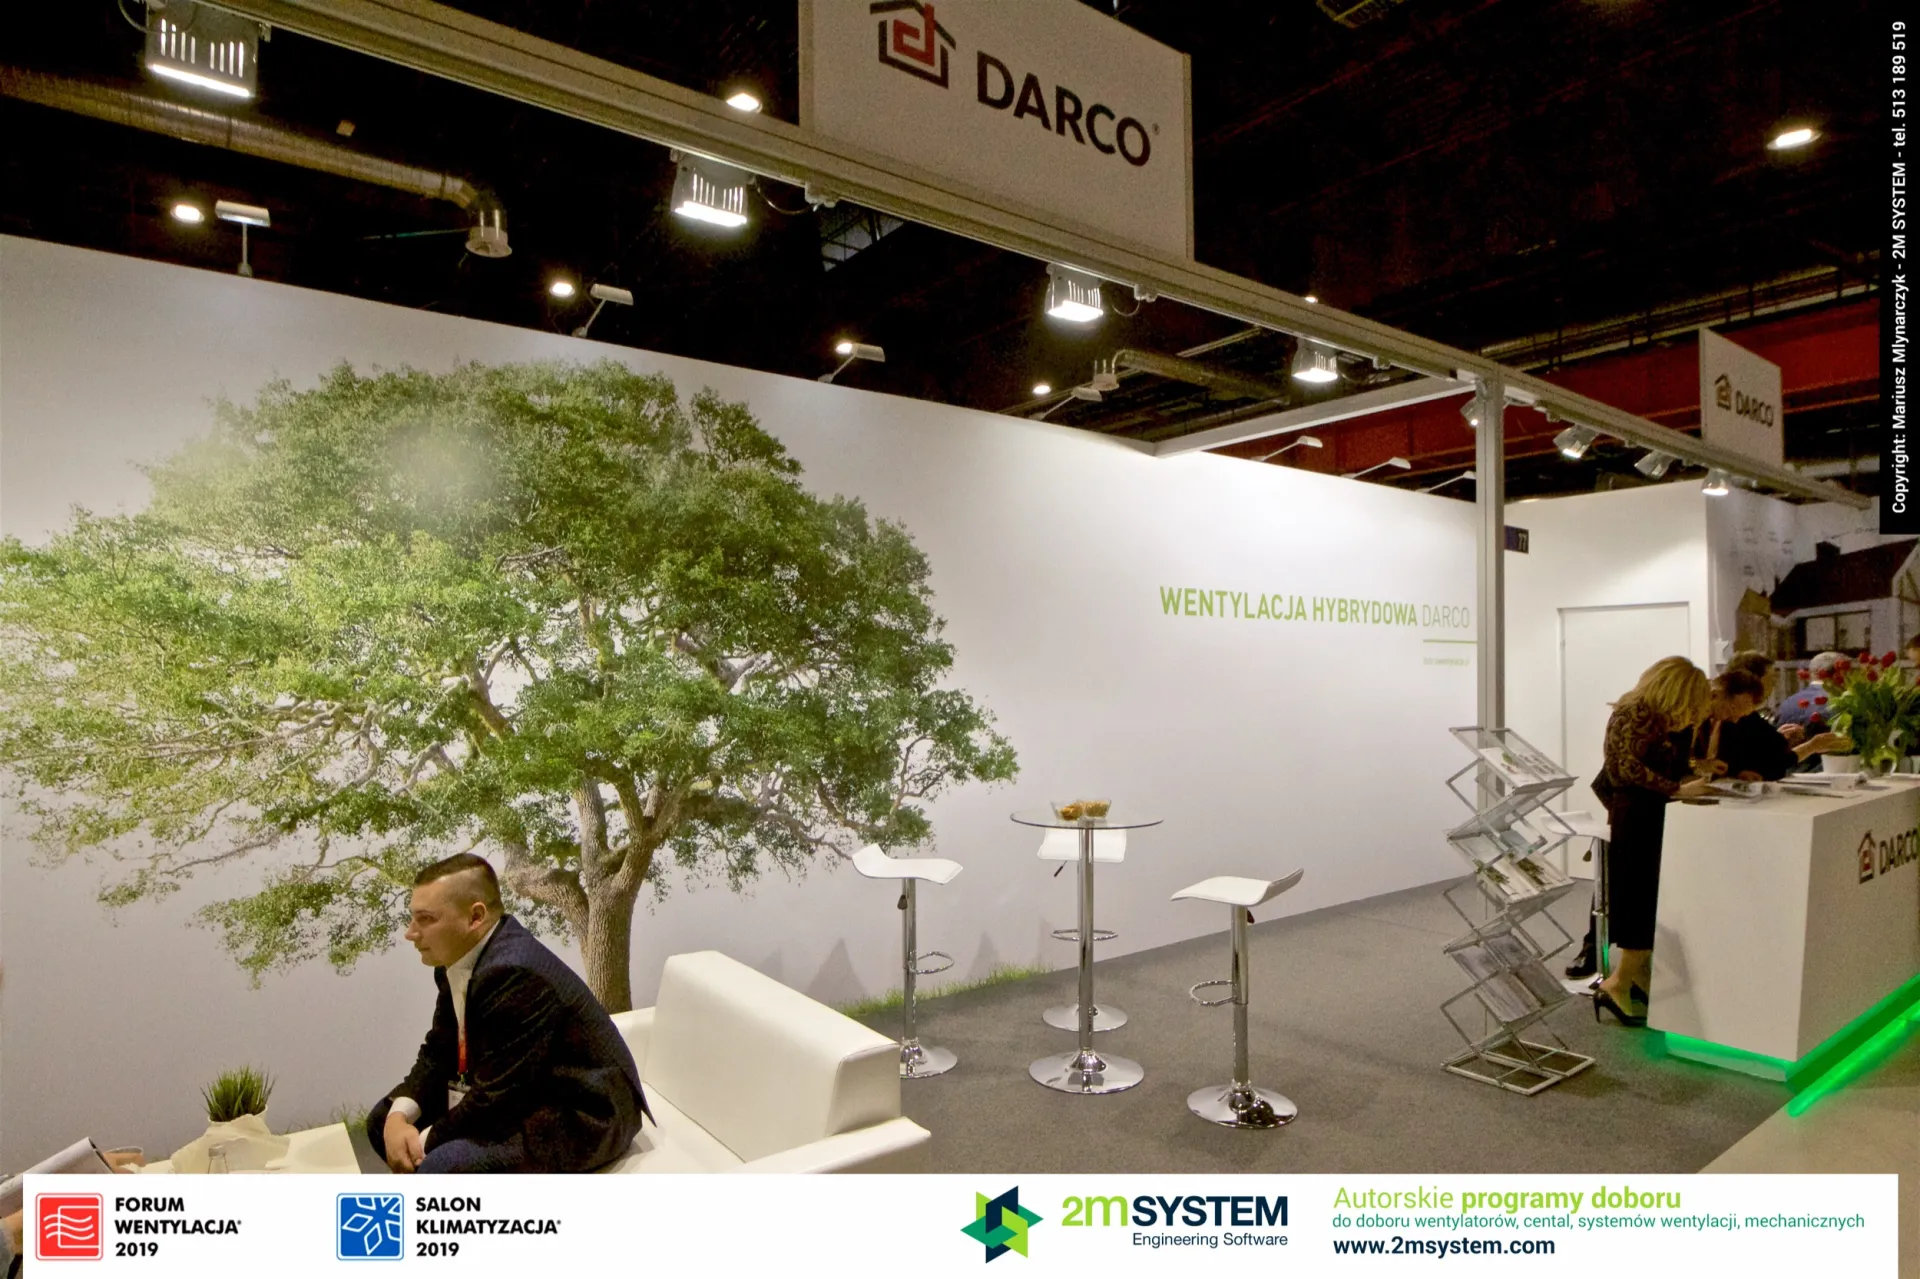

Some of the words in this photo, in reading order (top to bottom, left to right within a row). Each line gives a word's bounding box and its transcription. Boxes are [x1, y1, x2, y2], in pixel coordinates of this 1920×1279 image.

[977, 51, 1151, 167] DARCO
[1735, 390, 1774, 428] DARCO
[1160, 586, 1307, 621] WENTYLACJA
[1312, 597, 1418, 626] HYBRYDOWA
[1422, 605, 1470, 628] DARCO
